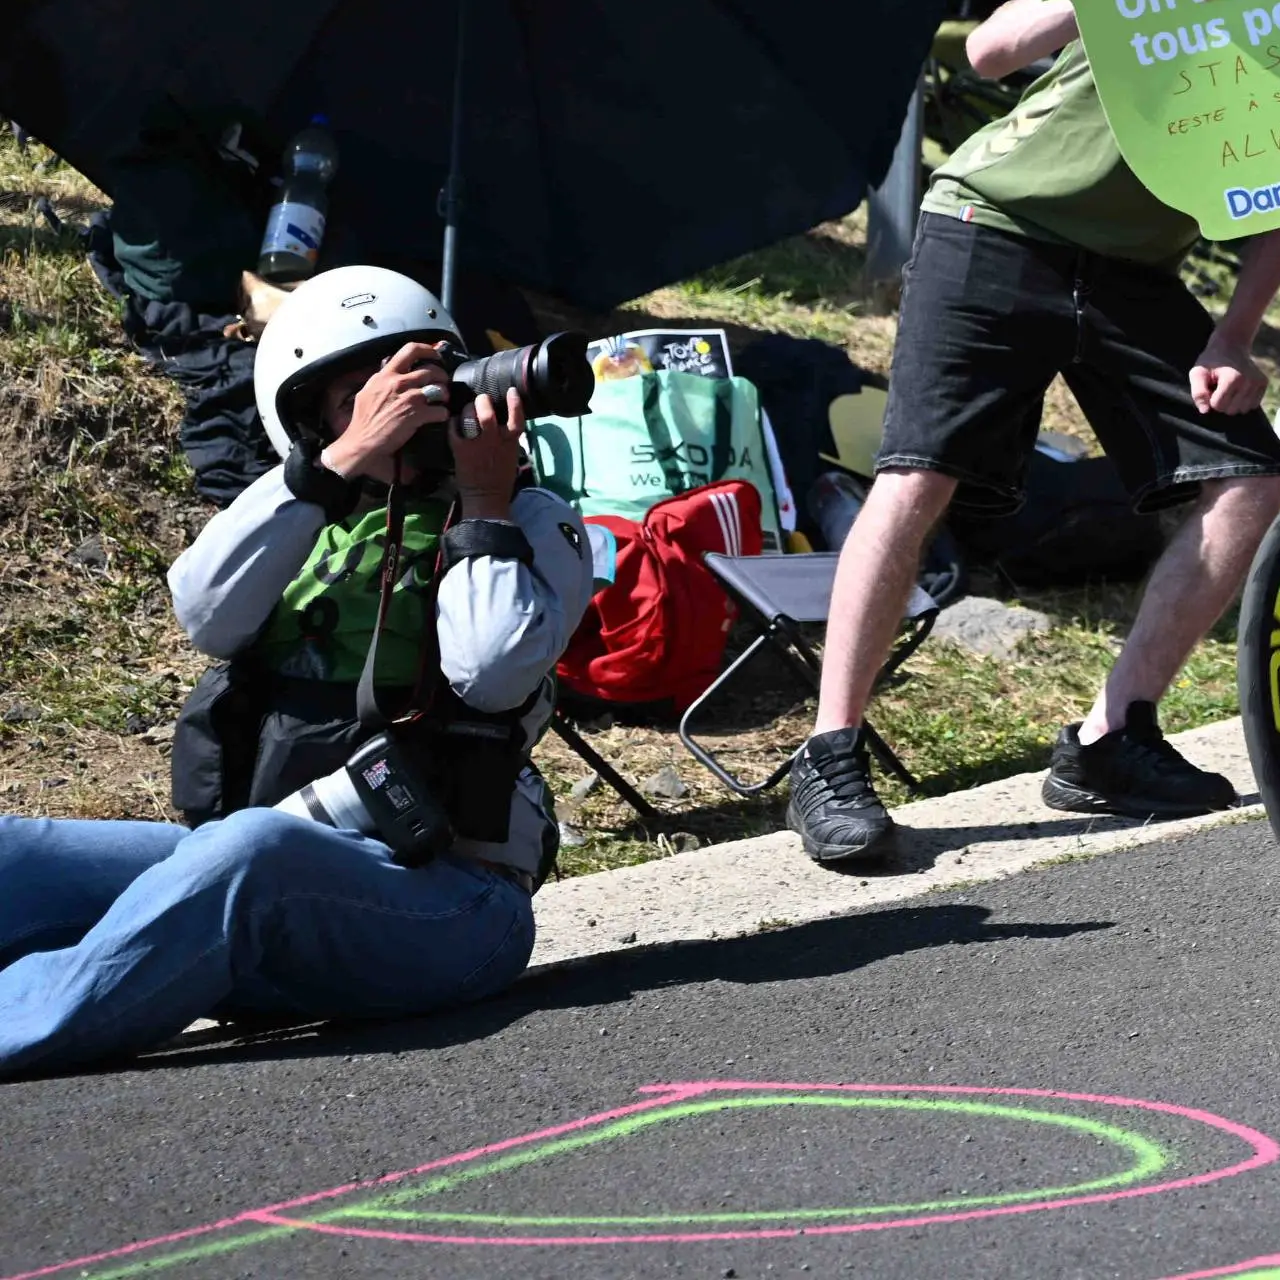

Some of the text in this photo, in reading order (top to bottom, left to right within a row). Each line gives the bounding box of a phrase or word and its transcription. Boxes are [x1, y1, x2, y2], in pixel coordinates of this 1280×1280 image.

[1129, 17, 1231, 66] tous
[1167, 107, 1227, 137] RESTE
[631, 473, 661, 487] We
[386, 543, 398, 583] EOS
